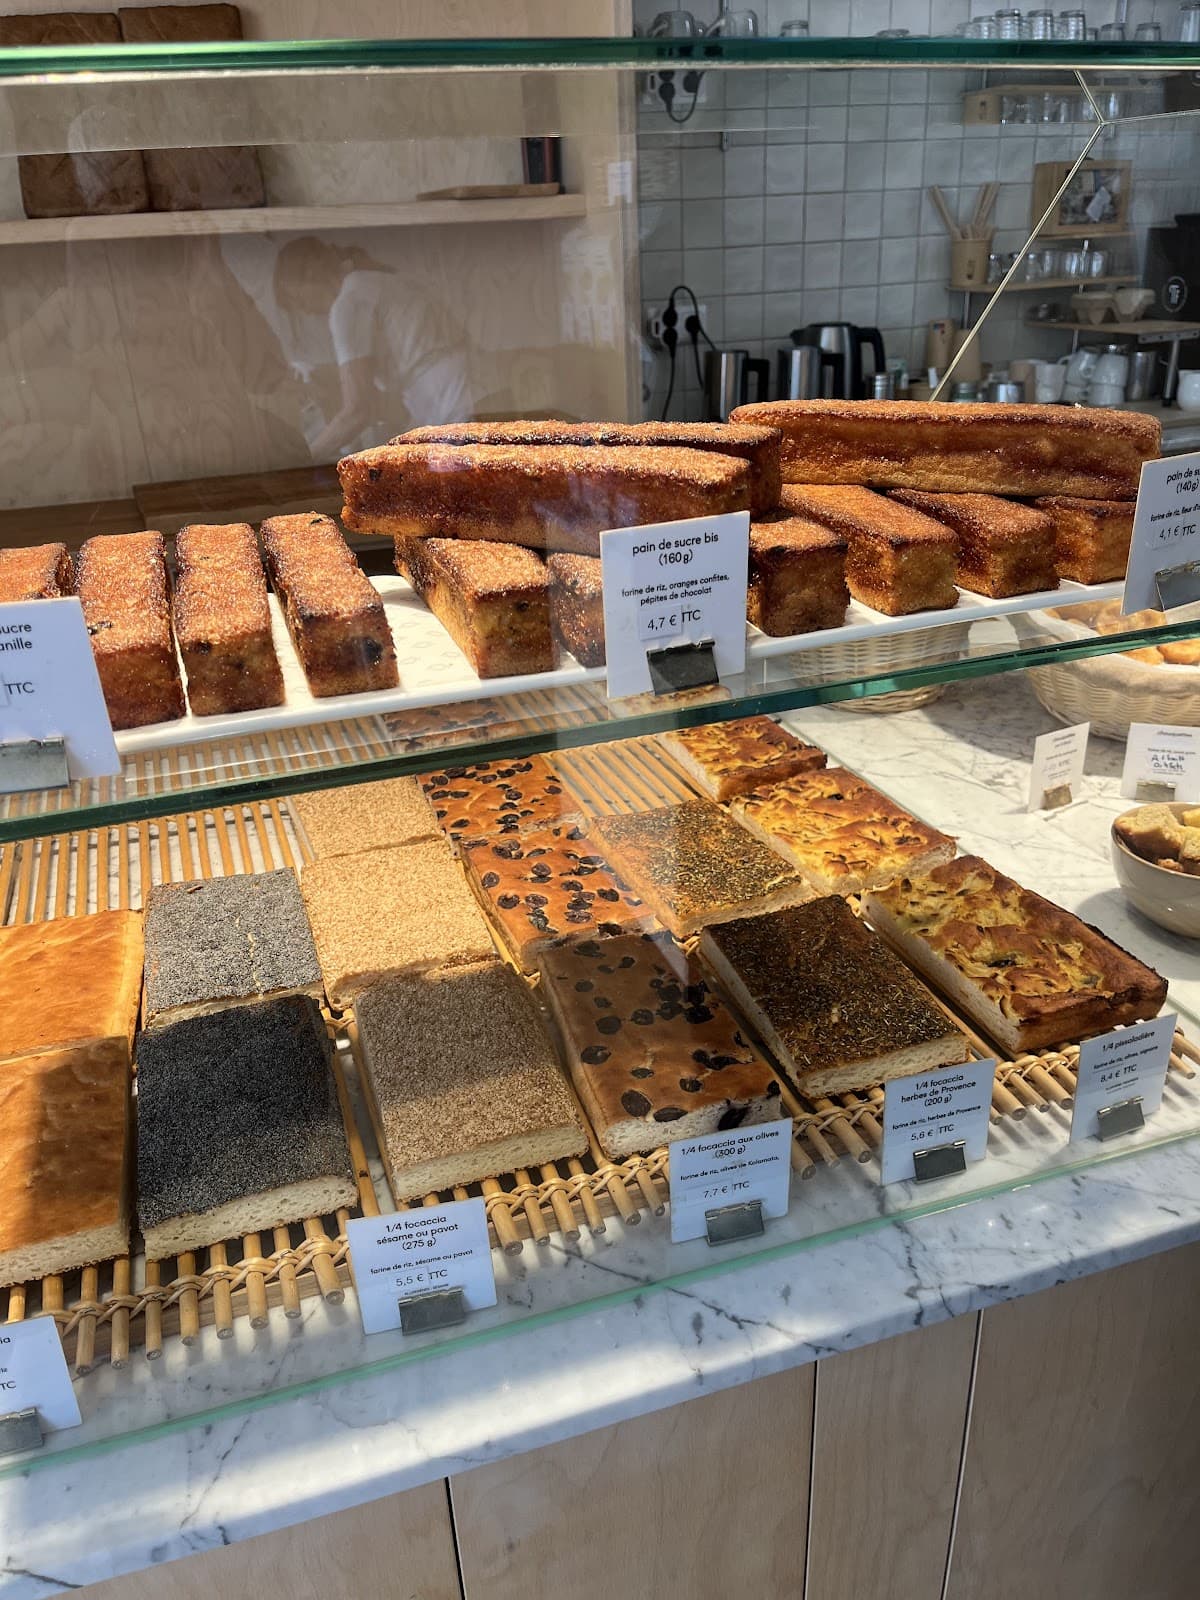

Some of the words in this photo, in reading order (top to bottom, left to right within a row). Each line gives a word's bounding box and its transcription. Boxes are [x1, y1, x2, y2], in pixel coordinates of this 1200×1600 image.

[1167, 472, 1182, 485] pain
[1184, 468, 1192, 478] de
[1174, 526, 1180, 536] €
[1182, 524, 1196, 536] TTC
[632, 542, 656, 556] pain
[658, 540, 671, 550] de
[674, 537, 701, 548] sucre
[704, 532, 719, 543] bis
[622, 588, 643, 597] farine
[645, 585, 654, 593] de
[670, 580, 698, 590] oranges
[700, 574, 730, 584] confites,
[640, 595, 668, 606] pépites
[680, 587, 712, 598] chocolat
[648, 617, 665, 631] 4,7
[669, 615, 677, 626] €
[681, 610, 701, 623] TTC
[4, 682, 35, 695] TTC
[1123, 1064, 1137, 1074] TTC
[916, 1081, 928, 1090] 1/4
[930, 1075, 964, 1087] focaccia
[901, 1092, 927, 1103] herbes
[941, 1081, 976, 1094] Provence
[893, 1122, 908, 1130] farine
[928, 1112, 946, 1121] herbes
[956, 1105, 981, 1114] Provence
[911, 1132, 924, 1140] 5,6
[939, 1124, 954, 1134] TTC
[681, 1146, 696, 1156] 1/4
[698, 1140, 735, 1152] focaccia
[738, 1135, 753, 1144] aux
[756, 1130, 779, 1140] olives
[681, 1173, 698, 1181] farine
[704, 1189, 718, 1199] 7,7
[733, 1181, 750, 1190] TTC
[386, 1223, 402, 1232] 1/4
[404, 1216, 447, 1229] focaccia
[377, 1234, 413, 1245] sésame
[415, 1230, 428, 1238] ou
[431, 1224, 459, 1236] pavot
[371, 1266, 391, 1275] farine
[415, 1255, 441, 1266] sésame
[453, 1249, 473, 1259] pavot
[396, 1276, 413, 1287] 5,5
[417, 1274, 424, 1282] €
[428, 1269, 448, 1280] TTC
